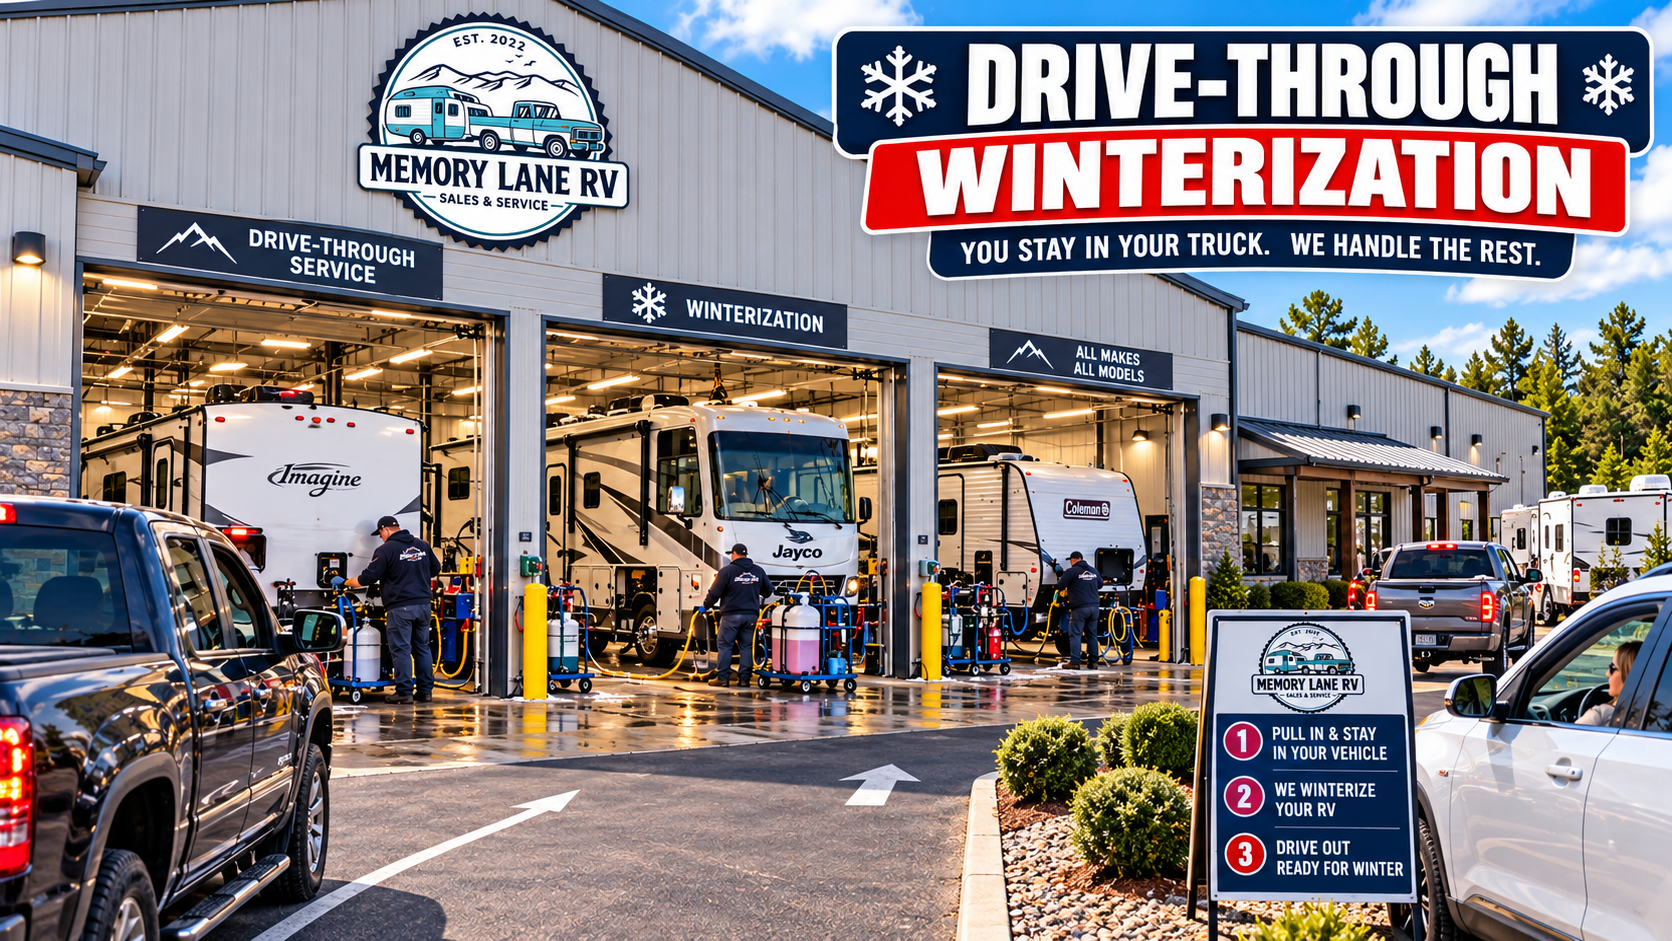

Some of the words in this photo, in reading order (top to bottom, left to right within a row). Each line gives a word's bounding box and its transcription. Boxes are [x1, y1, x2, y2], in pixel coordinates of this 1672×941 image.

[453, 33, 484, 48] EST.
[490, 33, 526, 51] 2022
[370, 152, 489, 188] MEMORY
[498, 161, 570, 195] LANE
[579, 167, 618, 199] RV
[439, 193, 479, 205] SALES
[483, 196, 492, 207] &
[496, 197, 549, 211] SERVICE
[249, 228, 415, 268] DRIVE-THROUGH
[290, 255, 376, 284] SERVICE
[686, 298, 824, 334] WINTERIZATION
[1076, 345, 1097, 361] ALL
[1101, 348, 1140, 366] MAKES
[1073, 361, 1095, 377] ALL
[1099, 365, 1144, 383] MODELS
[276, 463, 362, 497] Imagine
[1065, 500, 1101, 515] Coleman
[772, 544, 823, 561] Jayco
[1256, 678, 1306, 691] MEMORY
[1309, 678, 1338, 691] LANE
[1342, 678, 1359, 691] RV
[1236, 729, 1247, 753] 1
[1272, 726, 1306, 741] PULL
[1310, 727, 1324, 741] IN
[1328, 727, 1339, 741] &
[1343, 727, 1377, 742] STAY
[1273, 746, 1287, 760] IN
[1290, 746, 1327, 760] YOUR
[1331, 746, 1387, 761] VEHICLE
[1237, 784, 1252, 808] 2
[1274, 782, 1296, 797] WE
[1300, 782, 1376, 798] WINTERIZE
[1275, 802, 1312, 817] YOUR
[1317, 802, 1336, 817] RV
[1238, 842, 1253, 867] 3
[1276, 840, 1318, 855] DRIVE
[1322, 840, 1350, 855] OUT
[1276, 860, 1319, 876] READY
[1323, 861, 1349, 876] FOR
[1353, 861, 1404, 877] WINTER
